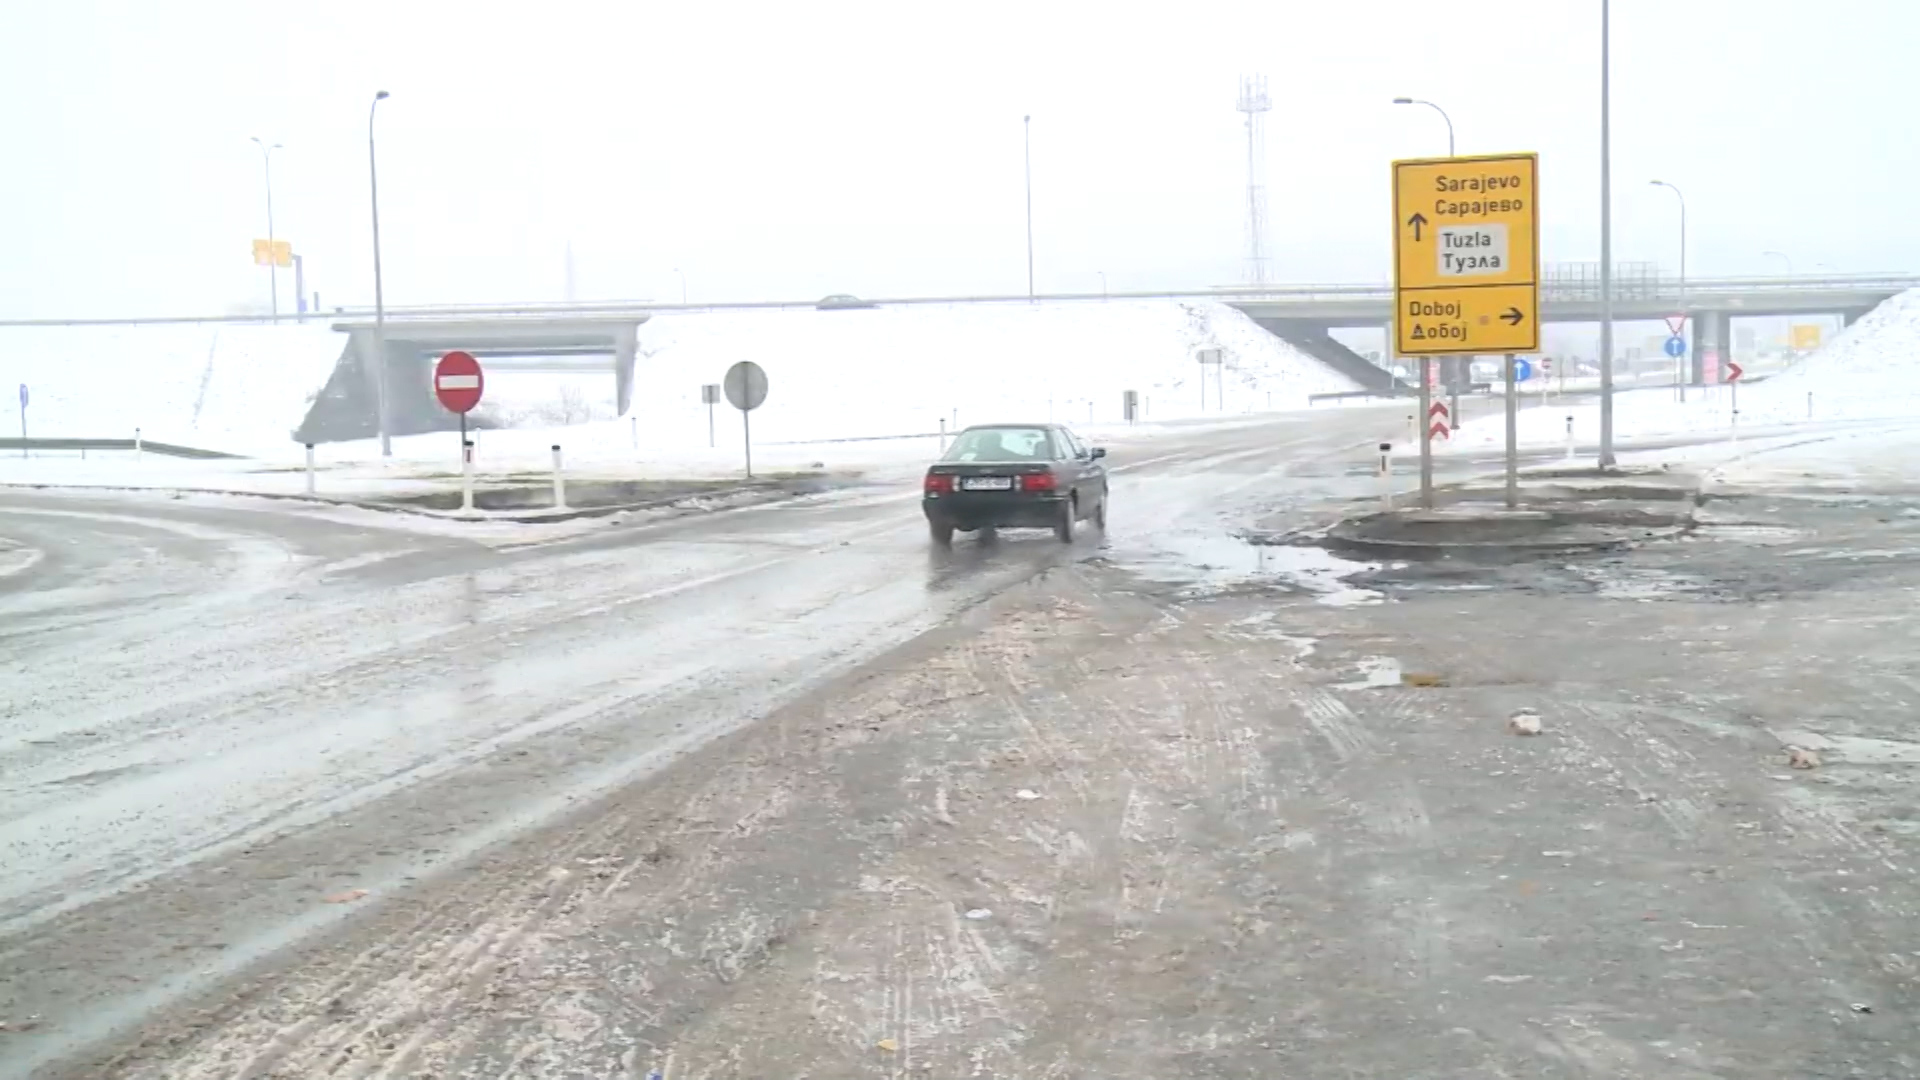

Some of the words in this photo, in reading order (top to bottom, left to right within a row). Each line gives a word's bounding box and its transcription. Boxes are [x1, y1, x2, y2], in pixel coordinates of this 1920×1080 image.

[1436, 173, 1521, 194] Sarajevo
[1435, 198, 1523, 217] Сарајево
[1442, 231, 1491, 248] Tuzla
[1442, 253, 1501, 274] Тузла
[1409, 300, 1461, 319] Doboj
[1410, 322, 1467, 341] Добој
